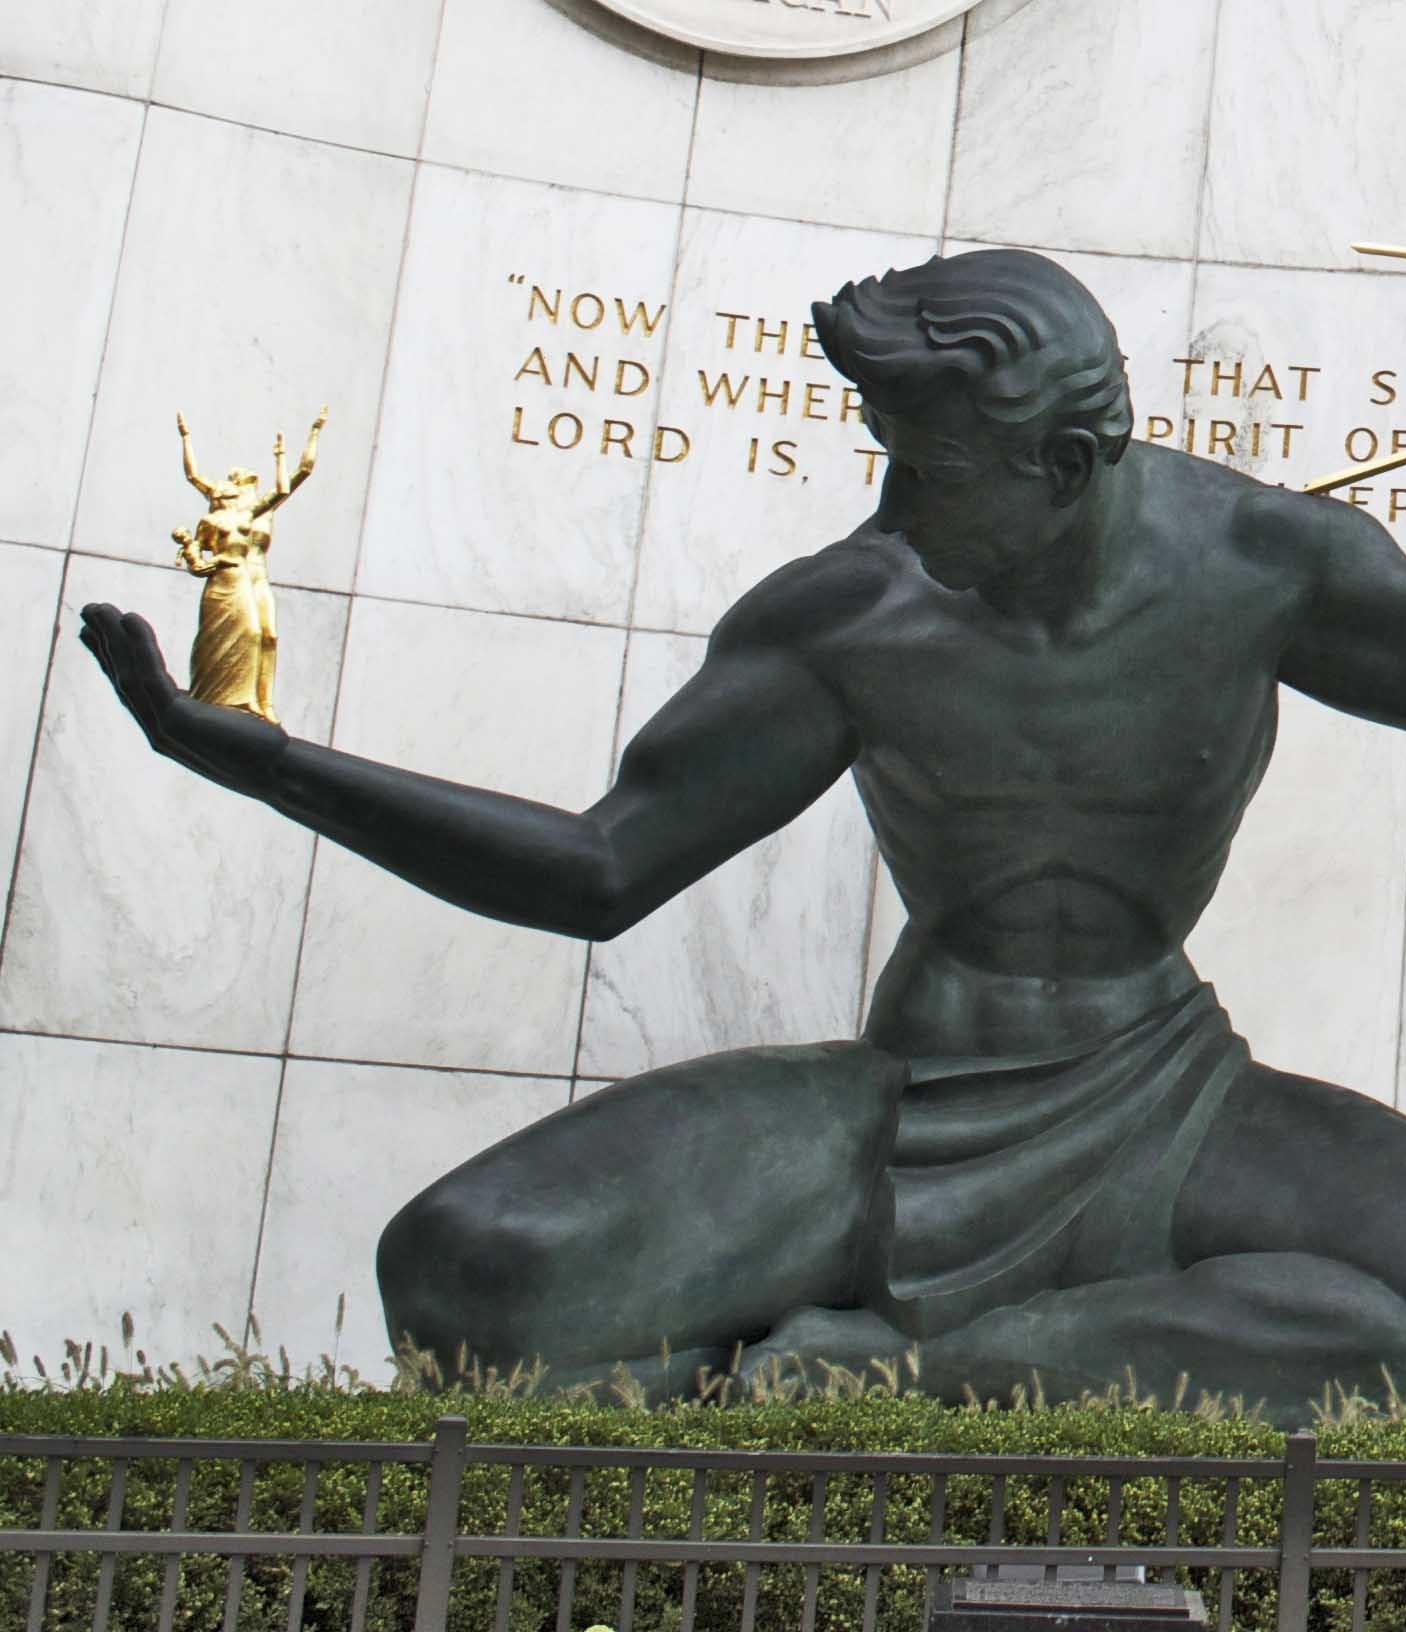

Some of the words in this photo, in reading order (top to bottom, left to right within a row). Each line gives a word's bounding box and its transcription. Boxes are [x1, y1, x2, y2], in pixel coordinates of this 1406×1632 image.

[715, 312, 825, 359] THE
[513, 346, 651, 397] AND
[697, 370, 866, 424] WHER
[1172, 358, 1322, 402] THAT
[511, 406, 691, 465] LORD
[746, 437, 809, 486] IS,
[1146, 415, 1304, 459] PIRIT
